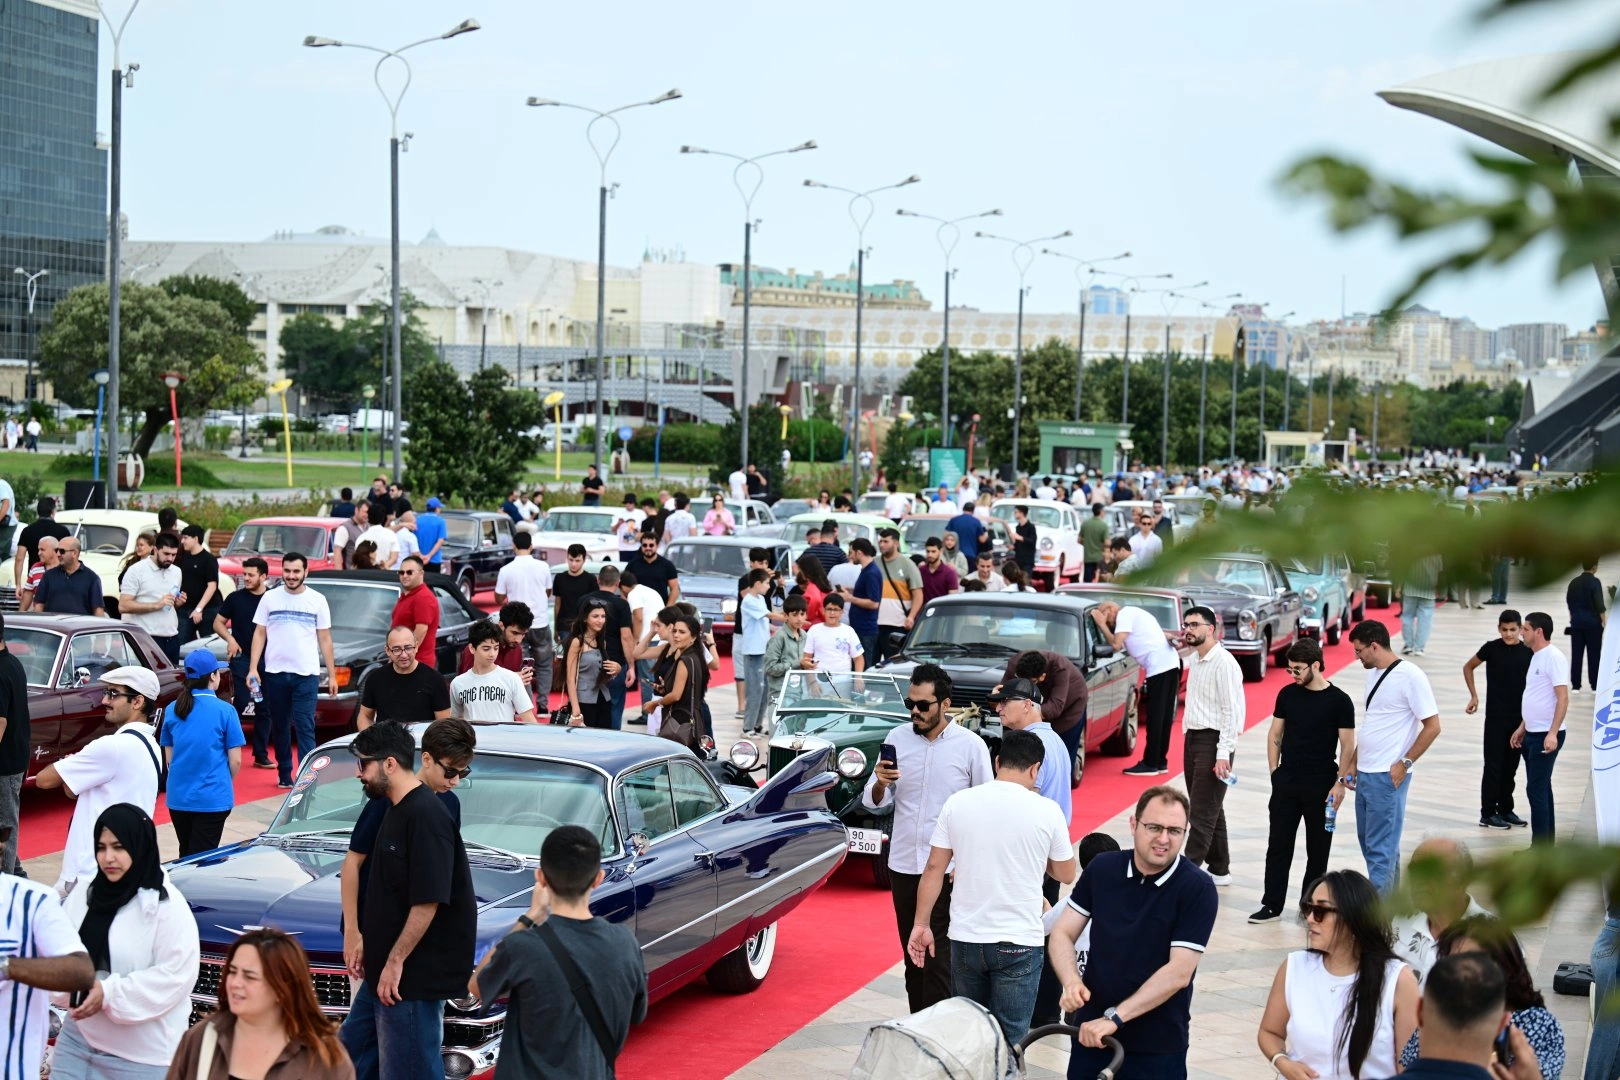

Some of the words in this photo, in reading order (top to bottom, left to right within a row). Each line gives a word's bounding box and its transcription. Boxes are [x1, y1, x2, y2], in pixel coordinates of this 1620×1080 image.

[479, 685, 506, 704] FREAK
[852, 830, 864, 840] 90
[858, 841, 876, 852] 500
